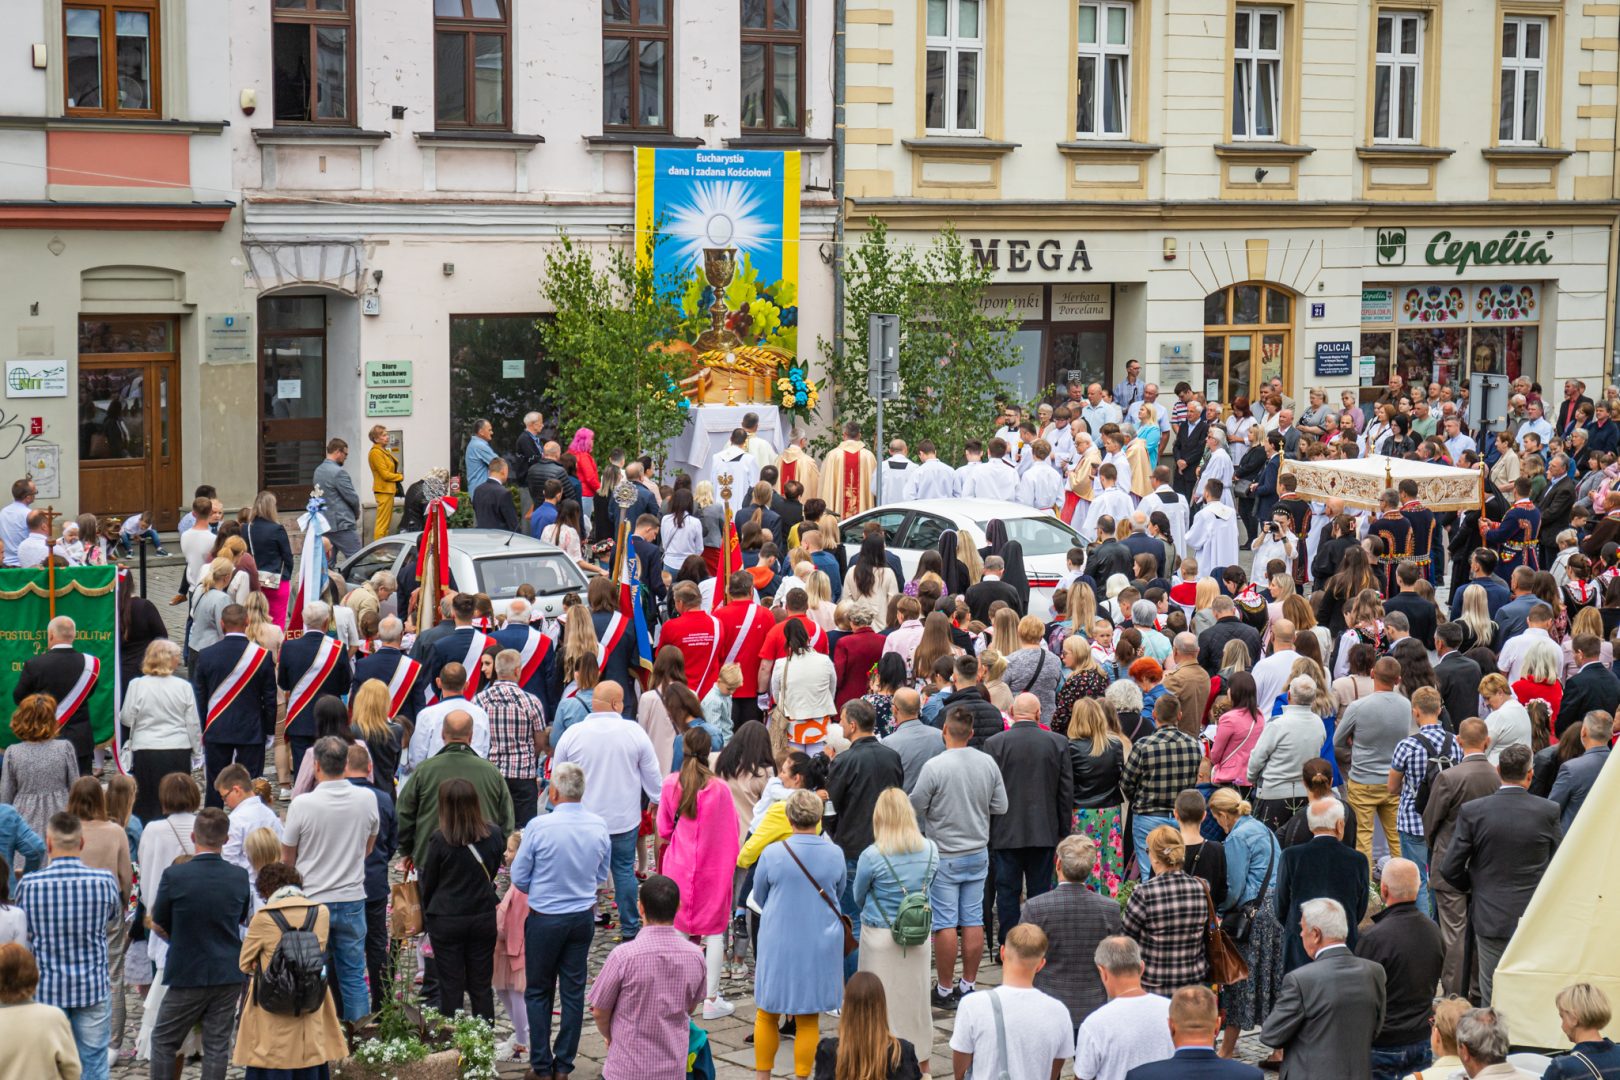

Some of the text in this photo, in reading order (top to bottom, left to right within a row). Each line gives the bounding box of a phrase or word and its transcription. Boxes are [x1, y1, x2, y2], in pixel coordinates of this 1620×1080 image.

[697, 153, 744, 165] Eucharystia
[668, 166, 689, 176] dana
[695, 166, 726, 177] zadana
[727, 167, 772, 177] Kościołowi
[969, 238, 1093, 272] MEGA
[1425, 230, 1554, 275] Cepelia
[1062, 292, 1101, 302] Herbata
[1059, 304, 1104, 315] Porcelana
[1318, 343, 1351, 352] POLICJA
[0, 630, 48, 640] POSTOLST
